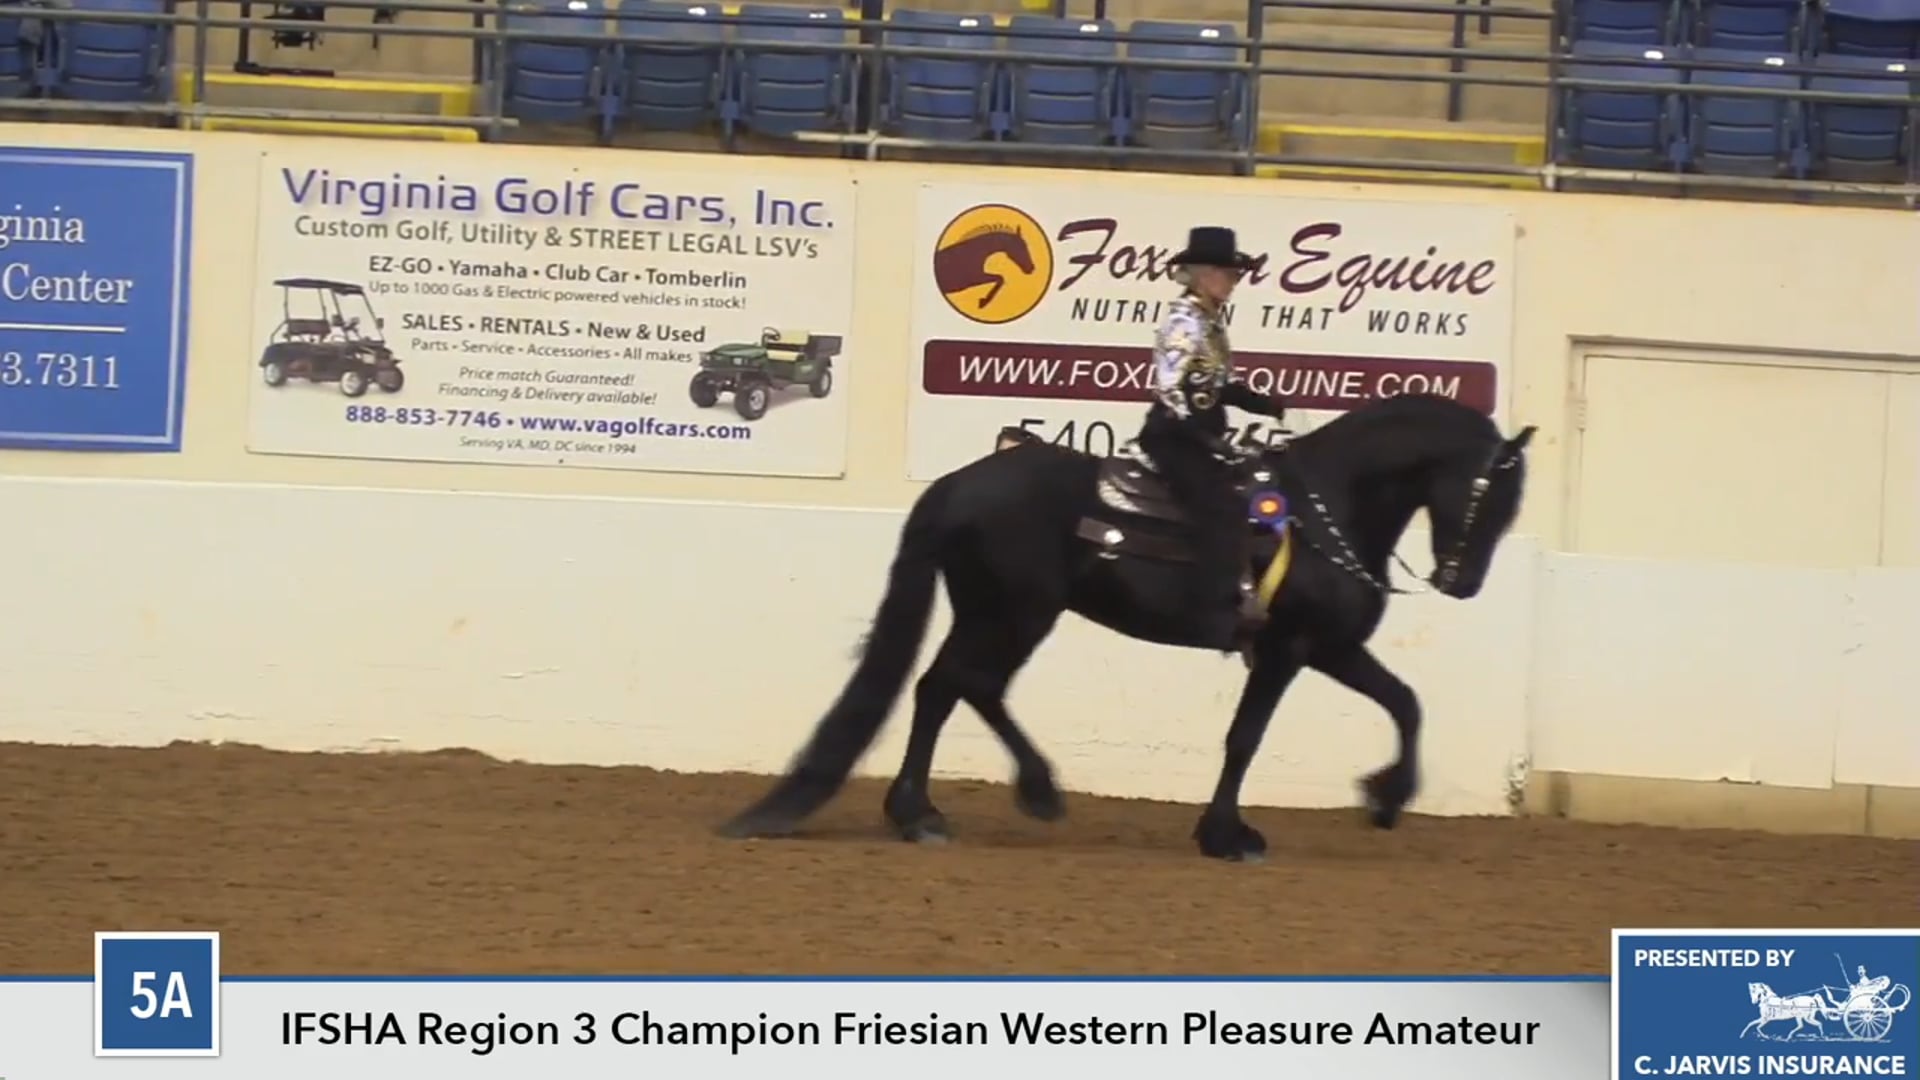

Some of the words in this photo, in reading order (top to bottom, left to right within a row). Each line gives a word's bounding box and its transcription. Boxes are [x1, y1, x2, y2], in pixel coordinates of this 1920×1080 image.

[282, 167, 477, 216] Virginia
[495, 177, 595, 217] Golf
[610, 183, 736, 229] Cars,
[755, 189, 834, 228] Inc.
[295, 215, 388, 239] Custom
[396, 219, 453, 244] Golf,
[461, 222, 537, 250] Utility
[544, 226, 562, 246] &
[569, 227, 661, 250] STREET
[668, 232, 748, 255] LEGAL
[369, 256, 432, 274] EZ-GO
[449, 259, 527, 279] Yamaha
[545, 264, 590, 281] Club
[596, 266, 629, 283] Car
[646, 268, 747, 288] Tomberlin
[1057, 218, 1271, 291] Foxn
[1279, 222, 1496, 313] Equine
[2, 262, 133, 304] Center
[369, 281, 390, 294] Up
[394, 282, 409, 294] to
[413, 282, 449, 295] 1000
[452, 284, 479, 297] Gas
[482, 285, 494, 297] &
[497, 286, 551, 301] Electric
[554, 288, 619, 305] powered
[622, 291, 681, 307] vehicles
[685, 294, 699, 307] in
[702, 295, 746, 309] stock!
[401, 313, 463, 332] SALES
[480, 316, 570, 337] RENTALS
[587, 321, 631, 340] New
[635, 324, 651, 340] &
[656, 325, 706, 343] Used
[1071, 298, 1236, 326] NUTRIN
[1261, 305, 1334, 331] THAT
[1367, 310, 1469, 336] WORKS
[411, 337, 448, 351] Parts
[461, 340, 515, 355] Service
[526, 343, 611, 360] Accessories
[622, 347, 642, 361] All
[646, 349, 693, 363] makes
[459, 366, 494, 380] Price
[497, 369, 542, 383] match
[544, 370, 635, 387] Guaranteed!
[958, 355, 1462, 400] WWW.FOXQUINE.COM
[438, 384, 509, 401] Financing
[511, 387, 523, 400] &
[525, 386, 585, 404] Delivery
[587, 391, 657, 406] available!
[346, 406, 501, 428] 888-853-7746
[520, 416, 751, 440] www.vagolfcars.com
[575, 442, 605, 454] since
[608, 443, 637, 453] 1994
